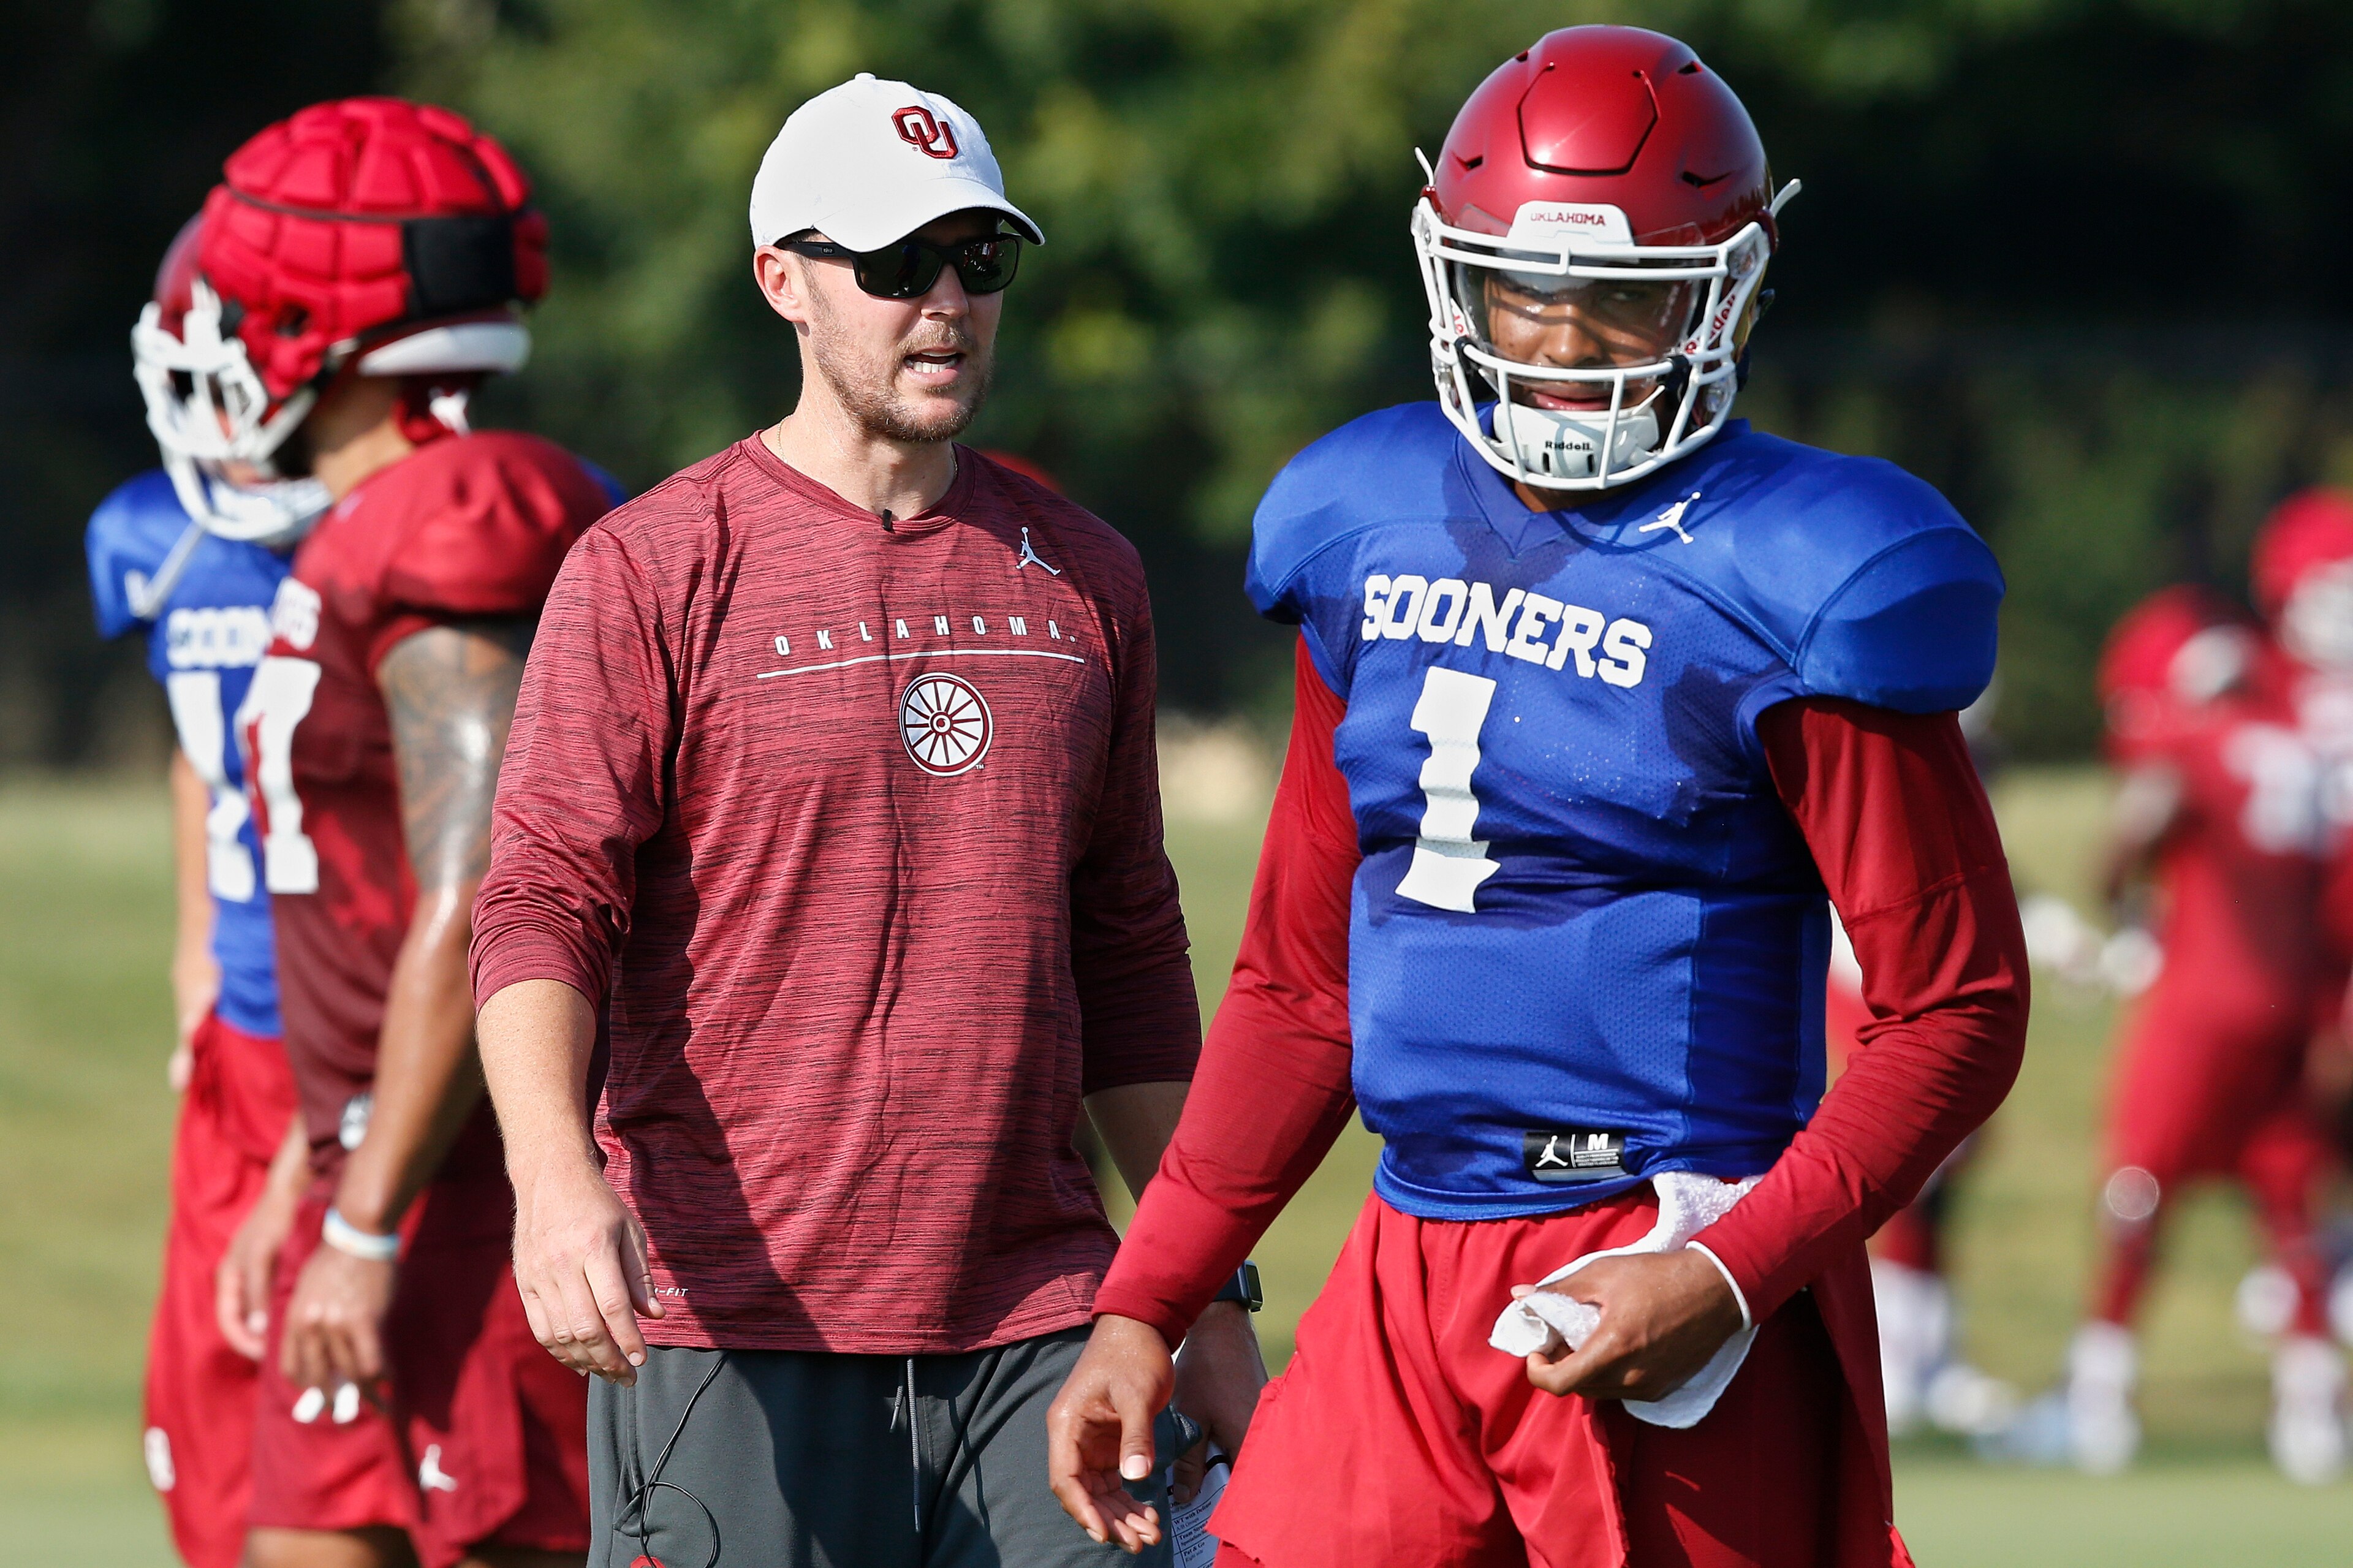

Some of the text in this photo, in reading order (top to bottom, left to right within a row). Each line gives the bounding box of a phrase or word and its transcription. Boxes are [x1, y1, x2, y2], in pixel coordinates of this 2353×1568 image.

[892, 105, 958, 159] OU
[1531, 212, 1605, 226] OKLAHOMA
[1545, 441, 1590, 450] Riddell
[774, 615, 1062, 656] OKLAHOMA
[1361, 574, 1653, 689] SOONERS
[1395, 665, 1501, 914] 1
[1587, 1133, 1609, 1151] M
[1179, 1531, 1192, 1540] Team
